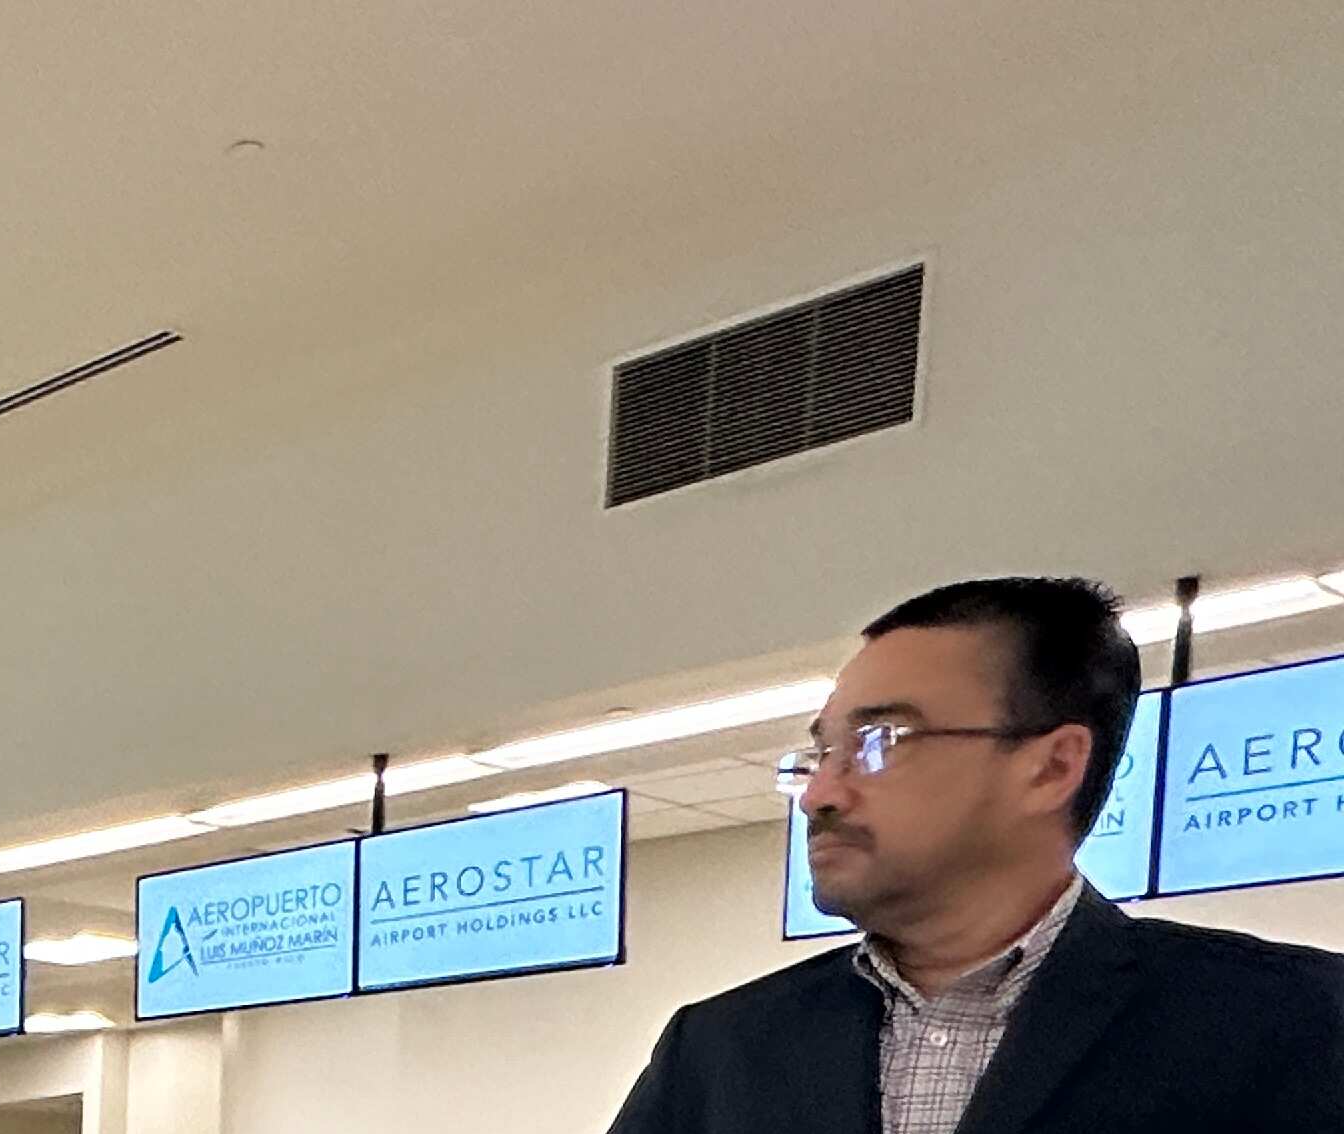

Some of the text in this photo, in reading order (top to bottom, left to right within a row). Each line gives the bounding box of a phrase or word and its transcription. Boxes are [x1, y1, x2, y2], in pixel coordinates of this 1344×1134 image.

[1183, 797, 1318, 832] AIRPORT
[370, 844, 606, 912] AEROSTAR
[186, 881, 343, 928] AEROPUERTO
[370, 900, 604, 948] AIRPORT HOLDINGS LLC
[199, 942, 227, 962] LUIS
